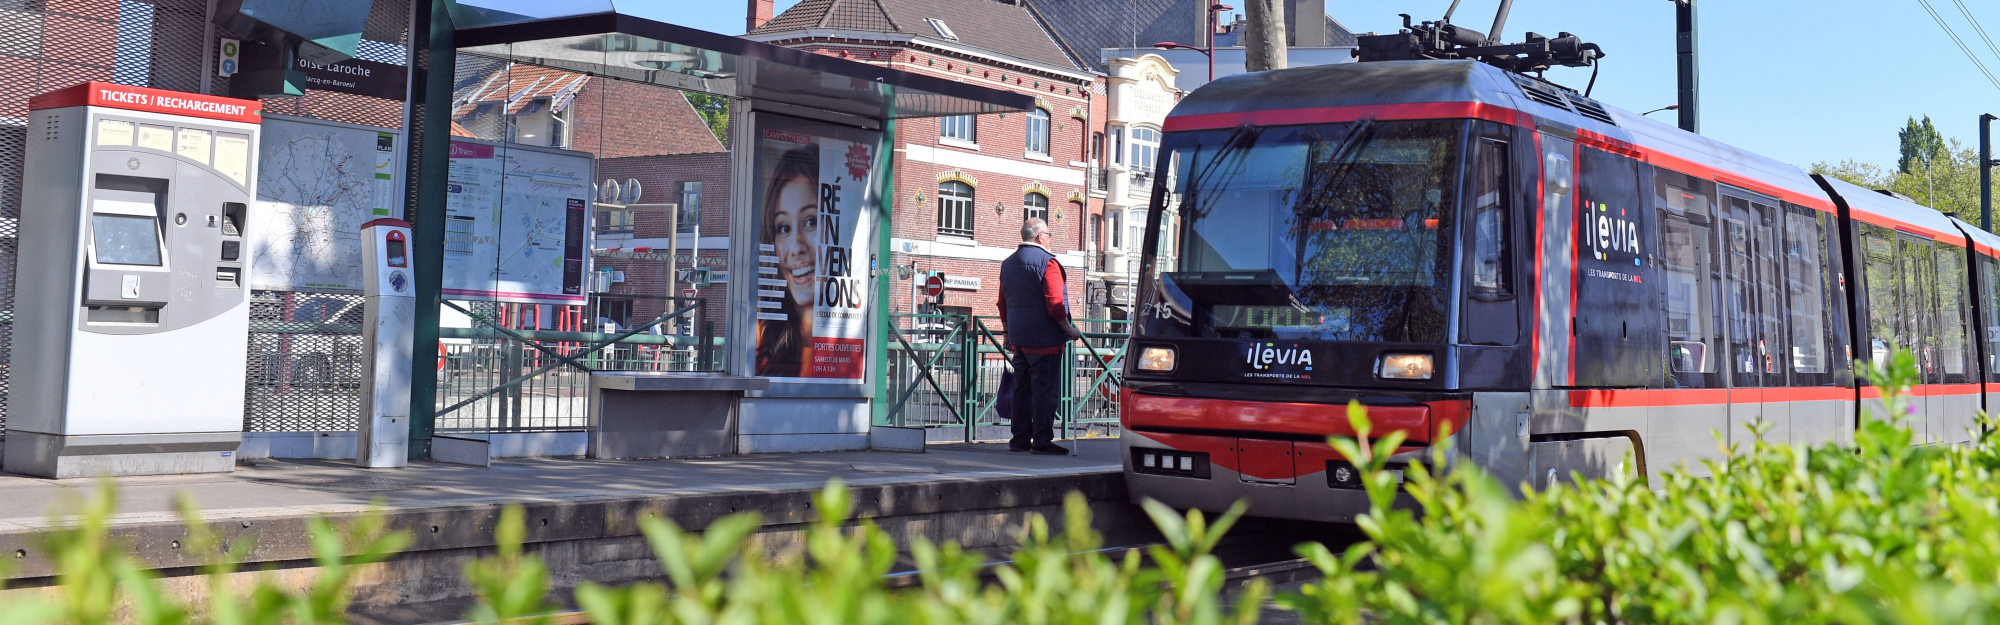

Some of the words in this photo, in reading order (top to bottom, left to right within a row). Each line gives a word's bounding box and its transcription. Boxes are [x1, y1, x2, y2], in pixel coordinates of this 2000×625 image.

[227, 45, 233, 54] R
[225, 62, 232, 71] T
[327, 63, 371, 77] Laroche
[100, 89, 148, 105] TICKETS
[150, 95, 154, 106] /
[156, 96, 246, 116] RECHARGEMENT
[765, 130, 788, 141] CAMPUS
[789, 134, 808, 144] LILLOIS
[377, 144, 392, 152] PLAN
[458, 147, 474, 156] Tram
[820, 176, 842, 215] RÉ
[820, 214, 840, 246] IN
[818, 245, 852, 278] VEN
[944, 277, 954, 285] NP
[953, 278, 978, 287] PARIBAS
[1596, 269, 1621, 280] TRANSPORTS
[1622, 273, 1628, 281] DE
[1634, 276, 1642, 284] MEL
[817, 277, 862, 309] TONS
[831, 311, 837, 319] DE
[837, 311, 859, 320] COMMERCE
[1154, 301, 1172, 319] 15
[1246, 307, 1313, 328] LILLE
[814, 342, 835, 352] PORTES
[835, 343, 862, 353] OUVERTES
[814, 355, 831, 363] SAMEDI
